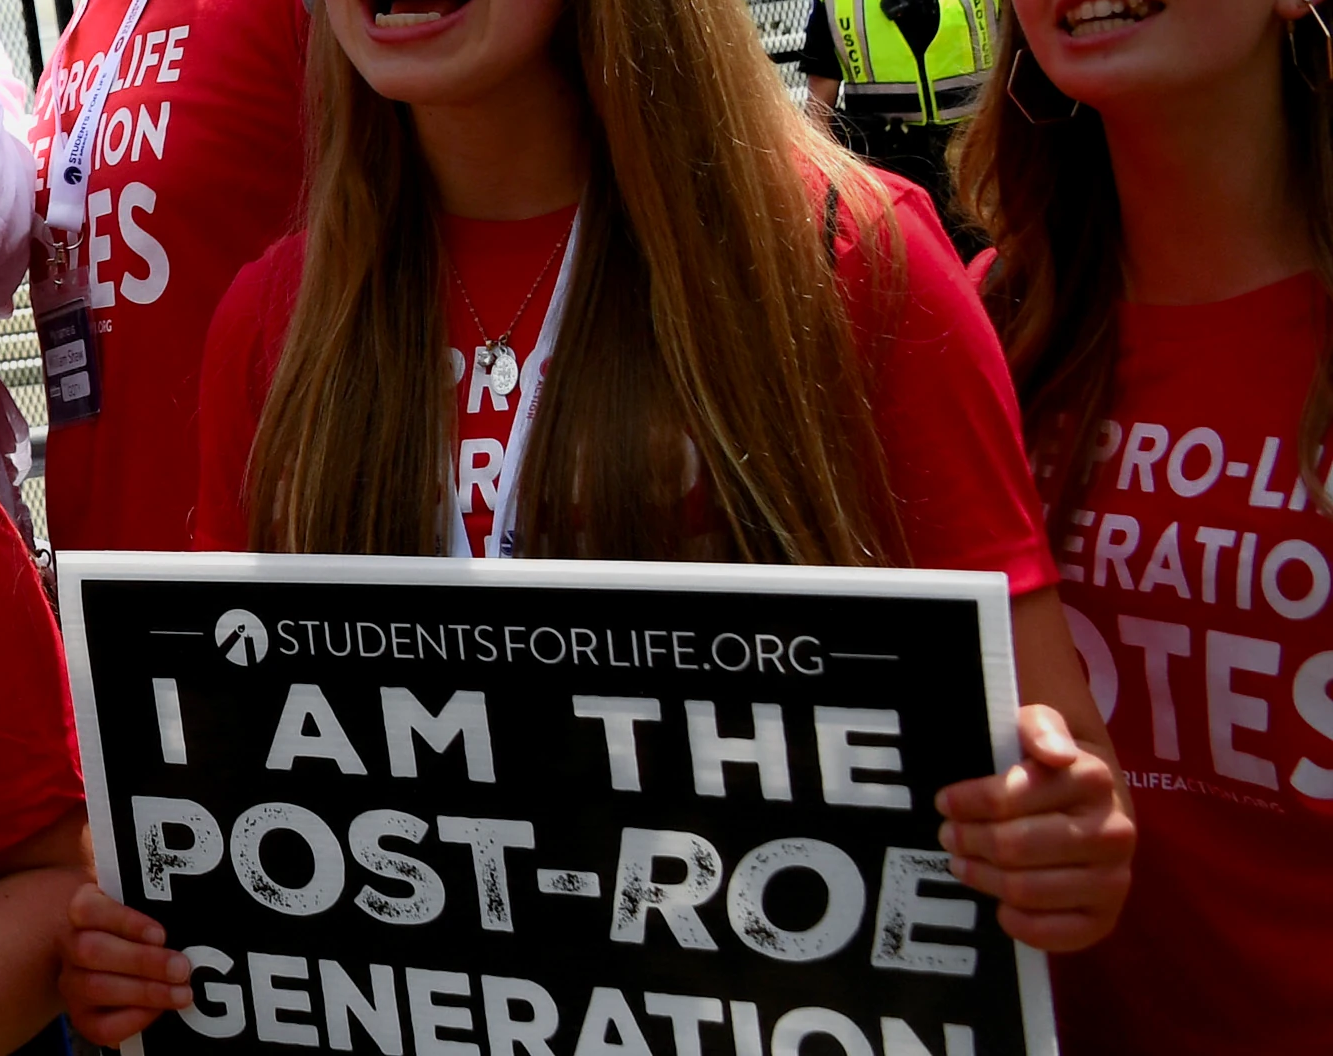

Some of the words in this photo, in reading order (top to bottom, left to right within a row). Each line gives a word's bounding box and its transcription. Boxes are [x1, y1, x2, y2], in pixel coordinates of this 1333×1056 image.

[839, 17, 862, 78] USCP
[68, 115, 91, 165] STUDENTS
[87, 93, 99, 114] FOR
[277, 618, 826, 676] STUDENTSFORLIFE.ORG
[152, 677, 188, 765] I
[265, 682, 497, 784] AM
[572, 695, 913, 811] THE
[130, 795, 980, 977] POST-ROE
